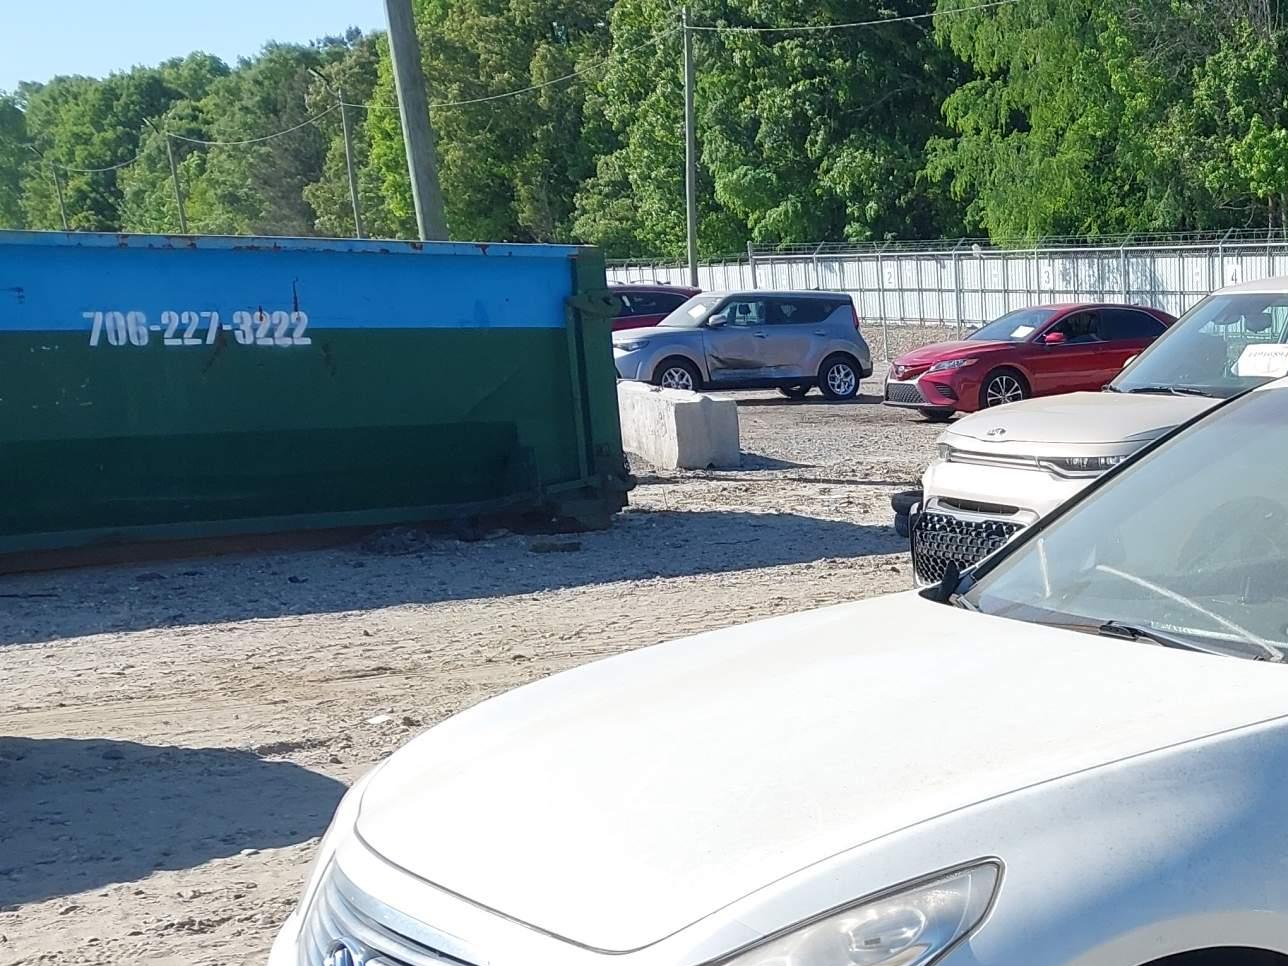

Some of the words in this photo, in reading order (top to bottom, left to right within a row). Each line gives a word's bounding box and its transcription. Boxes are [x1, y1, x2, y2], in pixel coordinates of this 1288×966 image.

[1043, 270, 1051, 284] 3
[1230, 268, 1238, 284] 4
[83, 311, 312, 347] 706-227-3222
